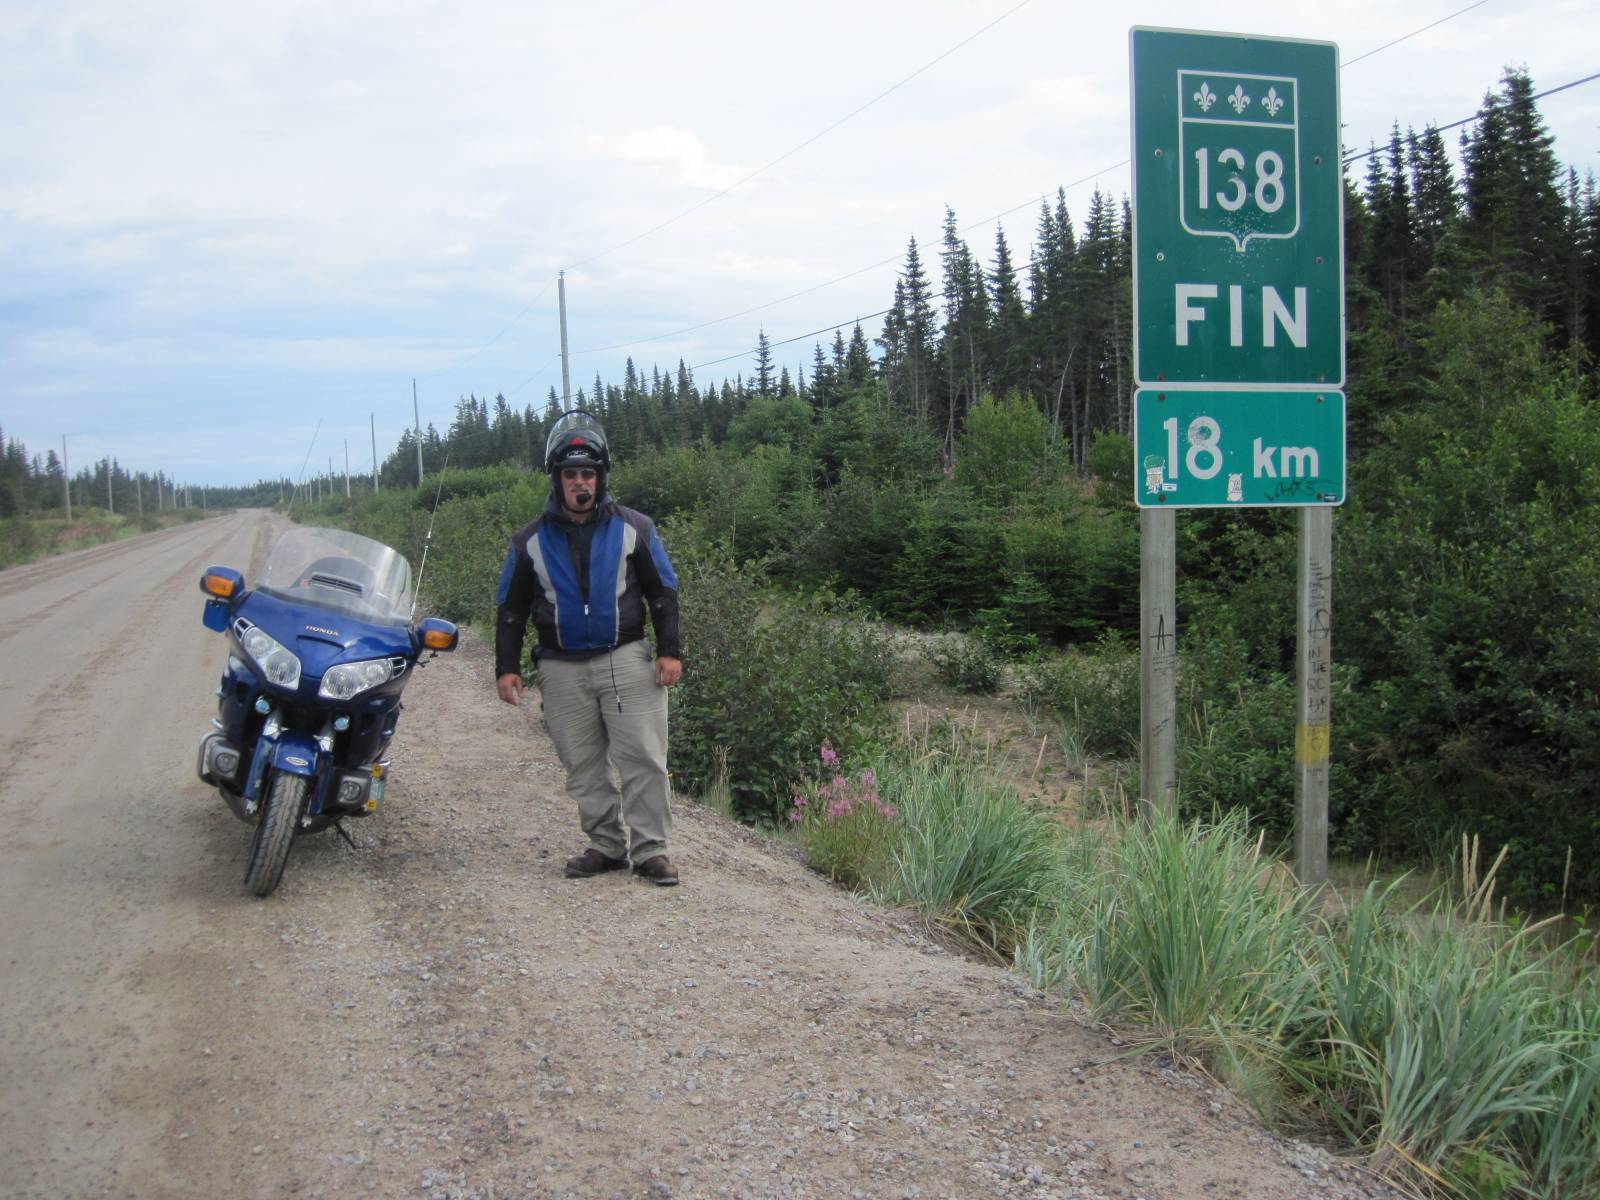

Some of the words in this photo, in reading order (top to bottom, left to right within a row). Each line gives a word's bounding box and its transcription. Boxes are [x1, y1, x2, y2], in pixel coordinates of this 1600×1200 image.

[1195, 147, 1285, 213] 138
[1175, 283, 1307, 348] FIN
[1163, 416, 1223, 480] 18
[1253, 437, 1319, 478] km
[305, 625, 339, 636] HONDA
